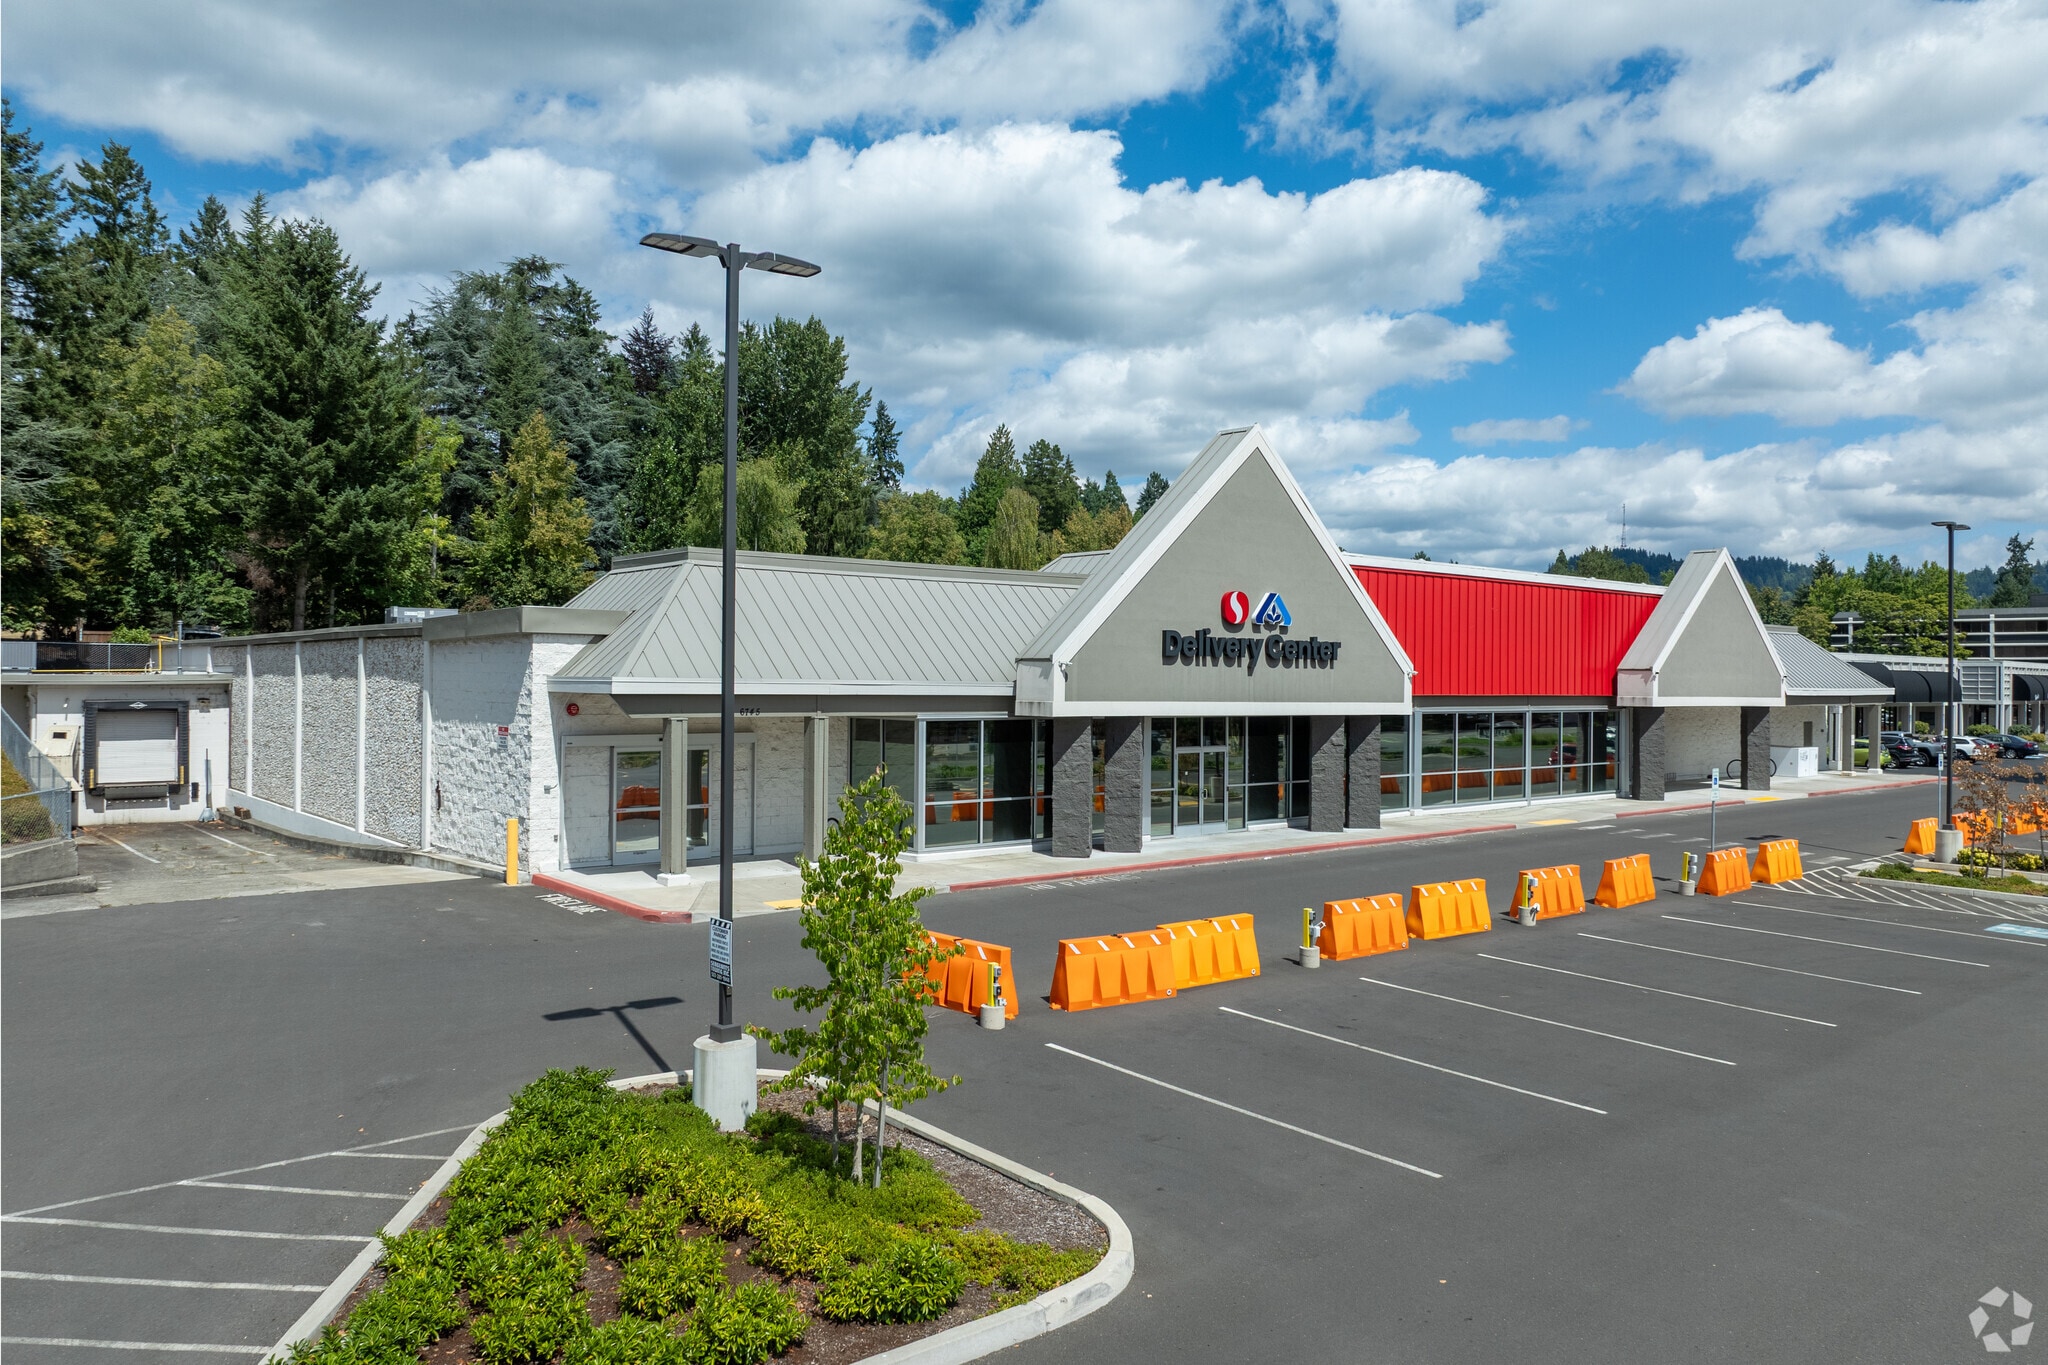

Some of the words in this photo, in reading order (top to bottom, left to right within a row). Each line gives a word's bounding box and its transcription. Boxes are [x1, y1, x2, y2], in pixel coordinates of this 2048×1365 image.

[1162, 628, 1264, 675] Delivery
[1265, 634, 1341, 661] Center
[740, 707, 761, 716] 6745
[534, 893, 584, 906] FIRE
